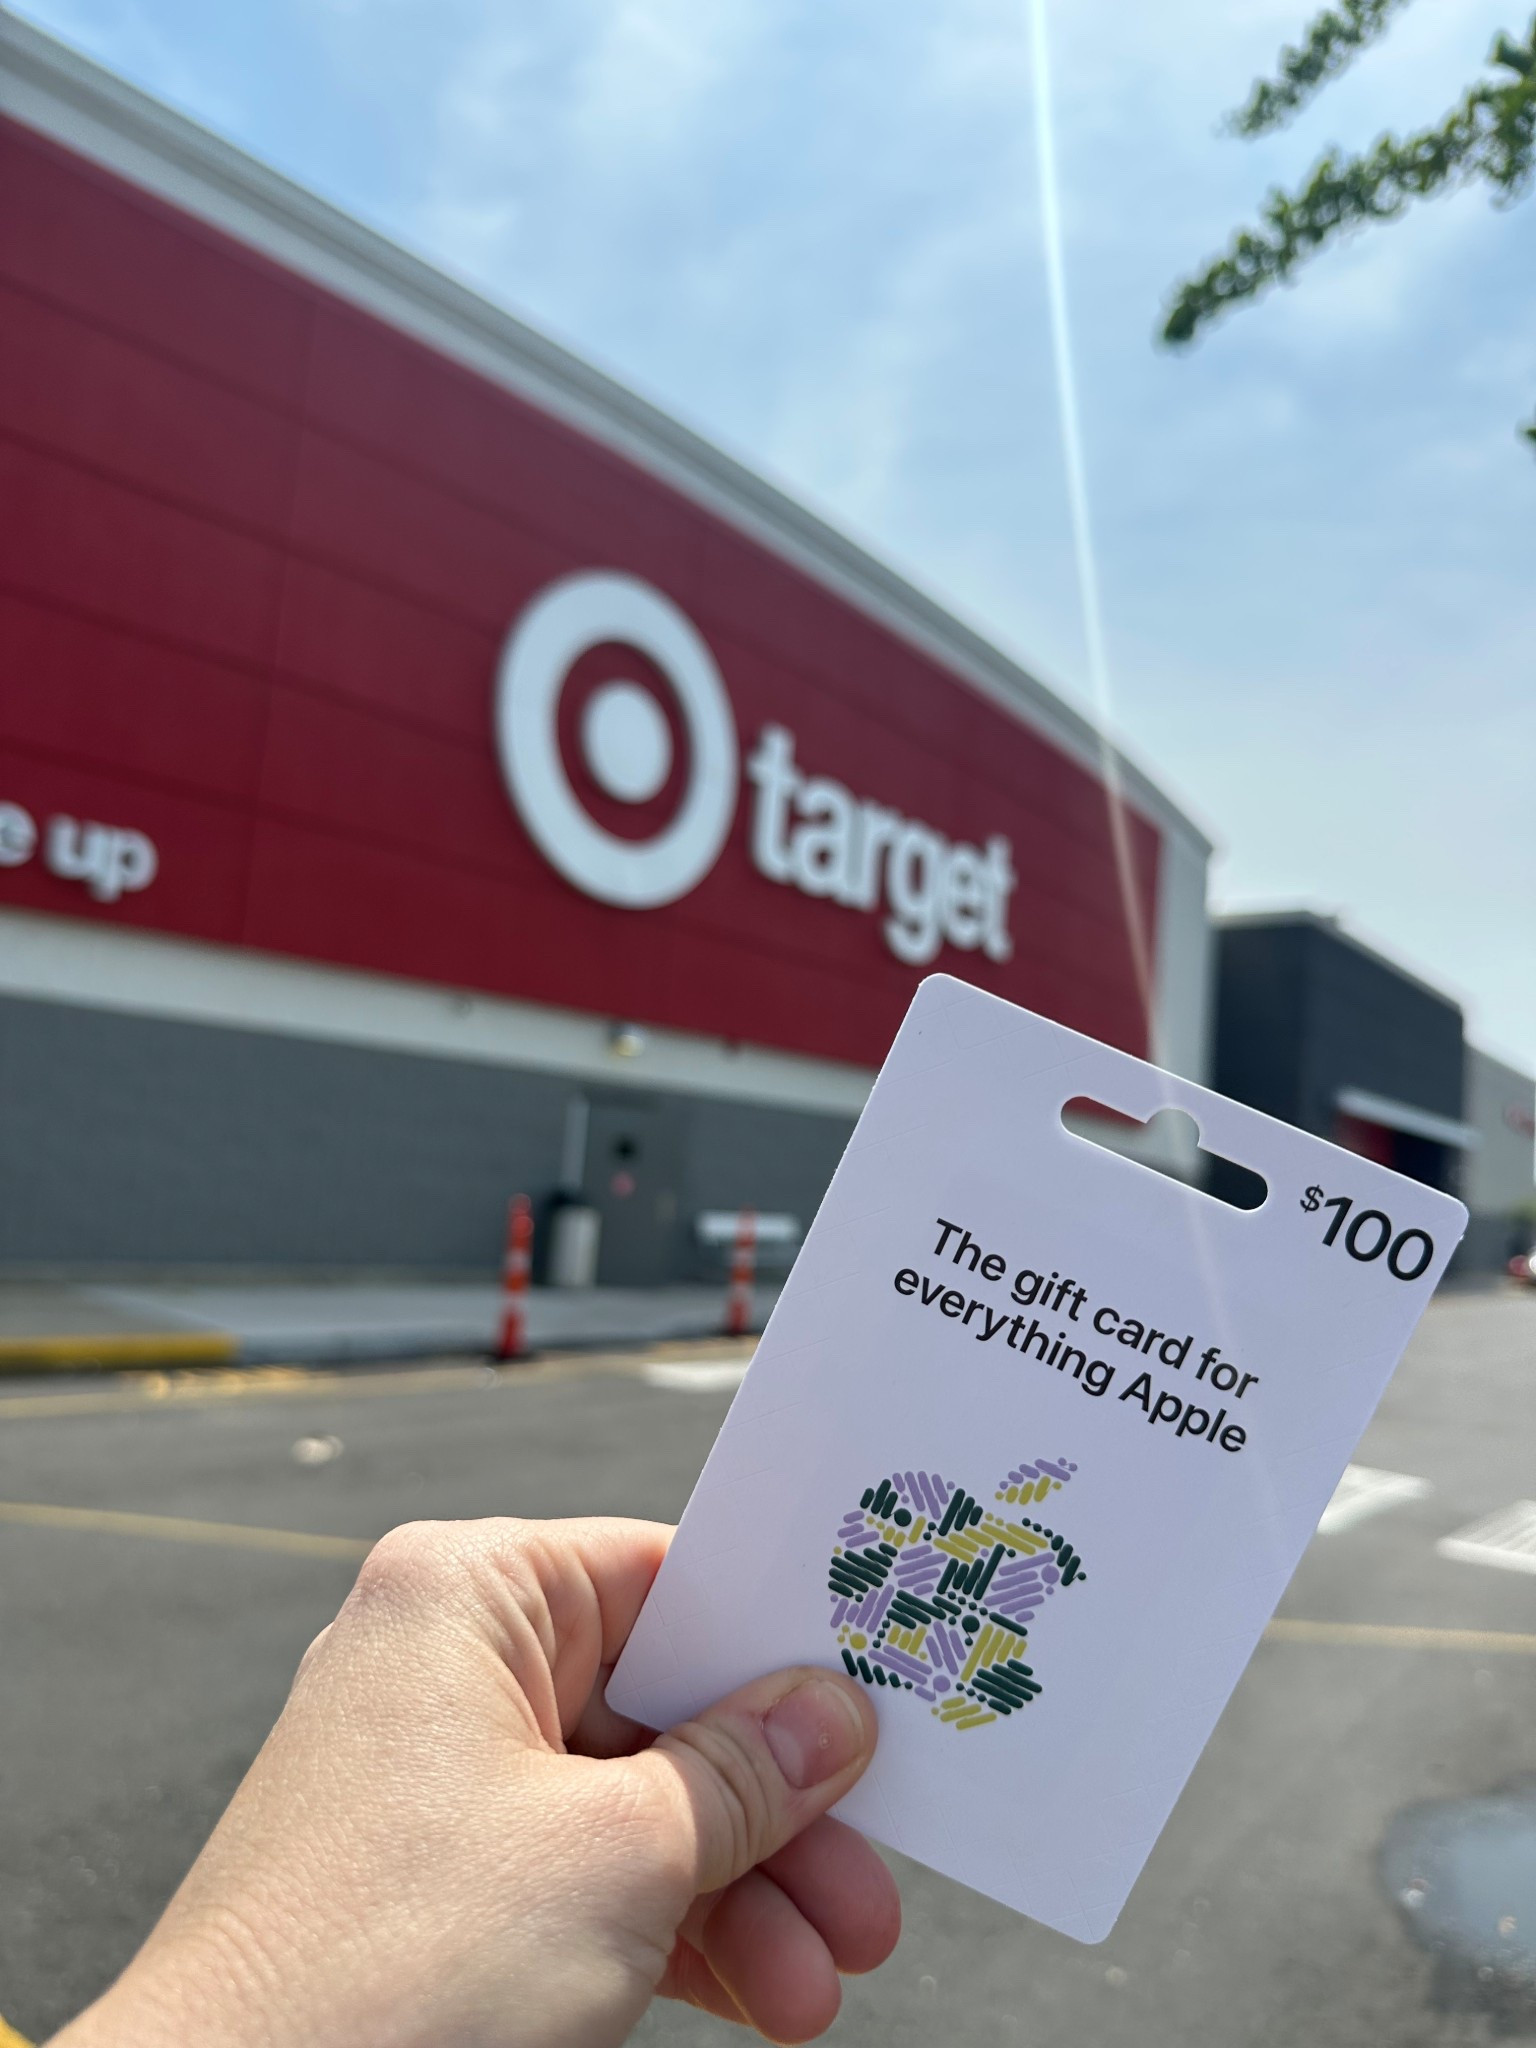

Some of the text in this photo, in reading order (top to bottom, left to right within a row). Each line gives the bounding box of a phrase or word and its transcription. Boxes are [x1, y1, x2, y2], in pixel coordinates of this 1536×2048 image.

[46, 812, 158, 904] up
[748, 723, 1016, 965] target
[934, 1218, 1260, 1399] The gift card for
[1300, 1184, 1434, 1281] $100
[894, 1268, 1247, 1453] everything Apple
